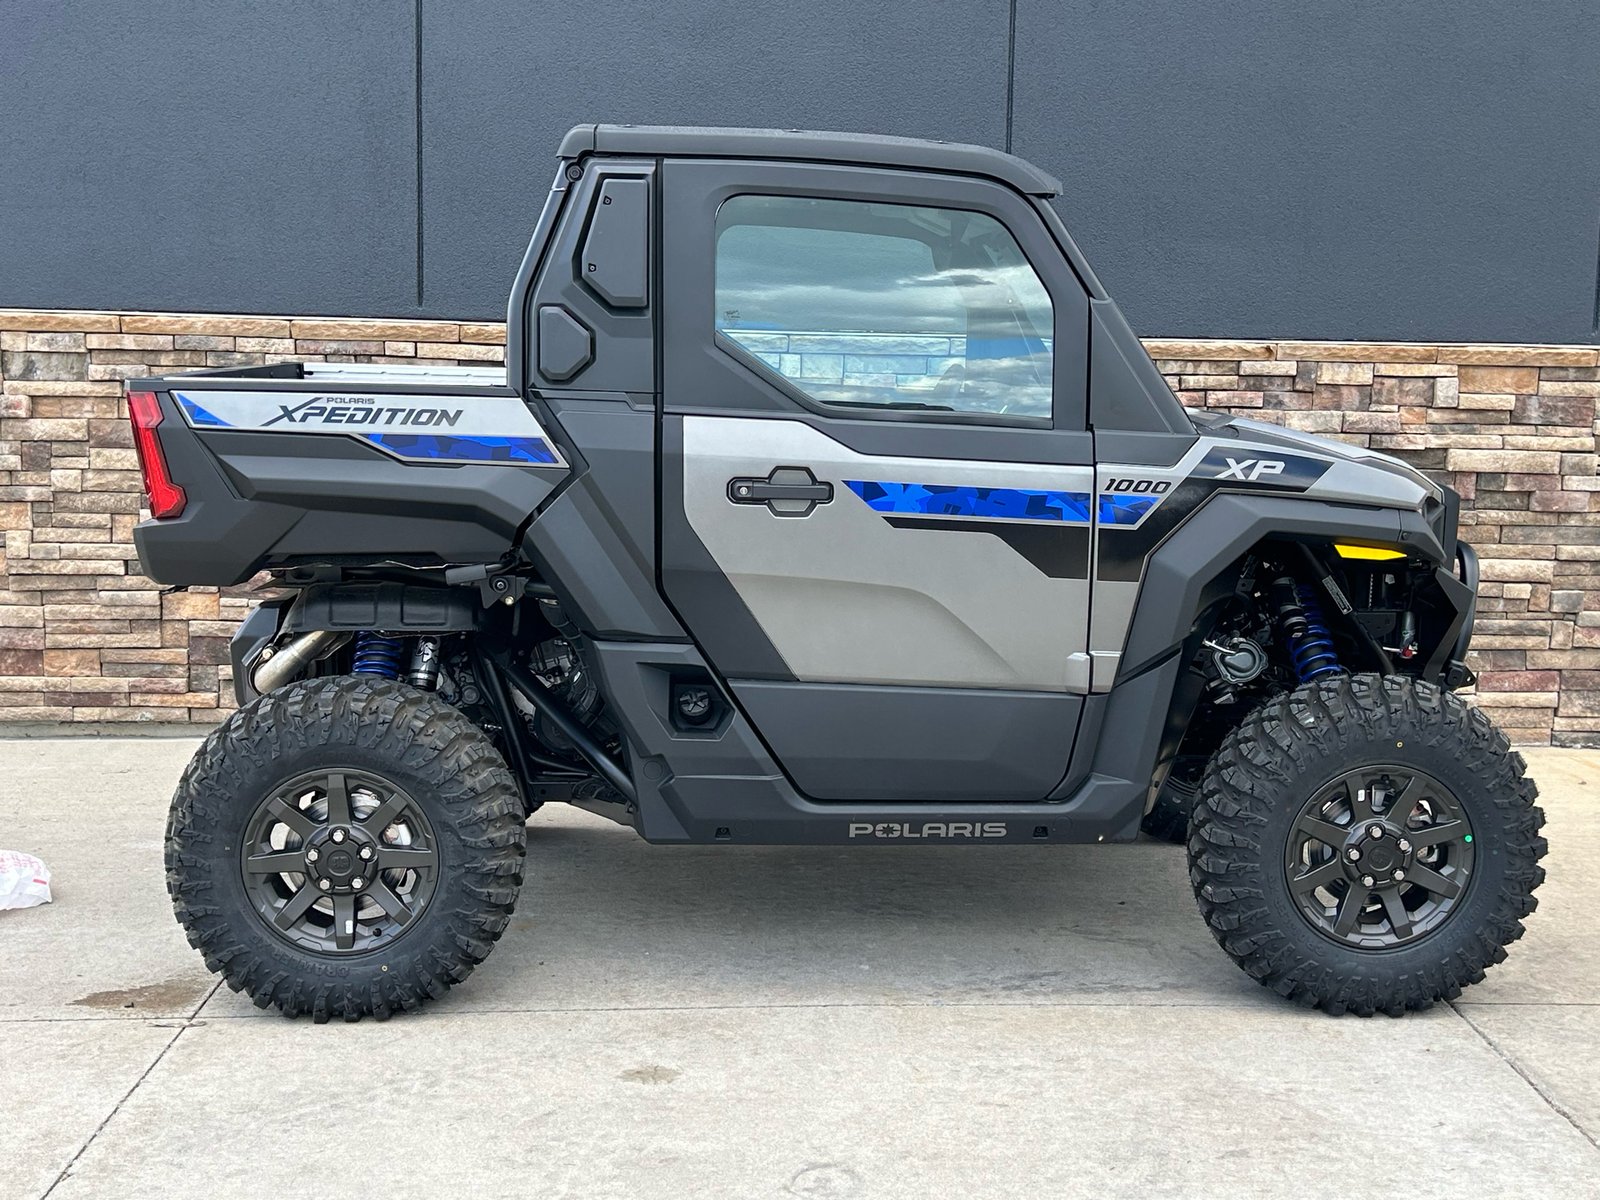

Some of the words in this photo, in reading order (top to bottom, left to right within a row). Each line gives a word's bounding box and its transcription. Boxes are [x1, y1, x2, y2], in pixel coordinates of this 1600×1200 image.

[326, 397, 376, 405] POLARIS
[259, 397, 464, 427] XPEDITION
[1214, 457, 1286, 481] XP
[1103, 478, 1172, 494] 1000
[848, 822, 1007, 839] POLARIS
